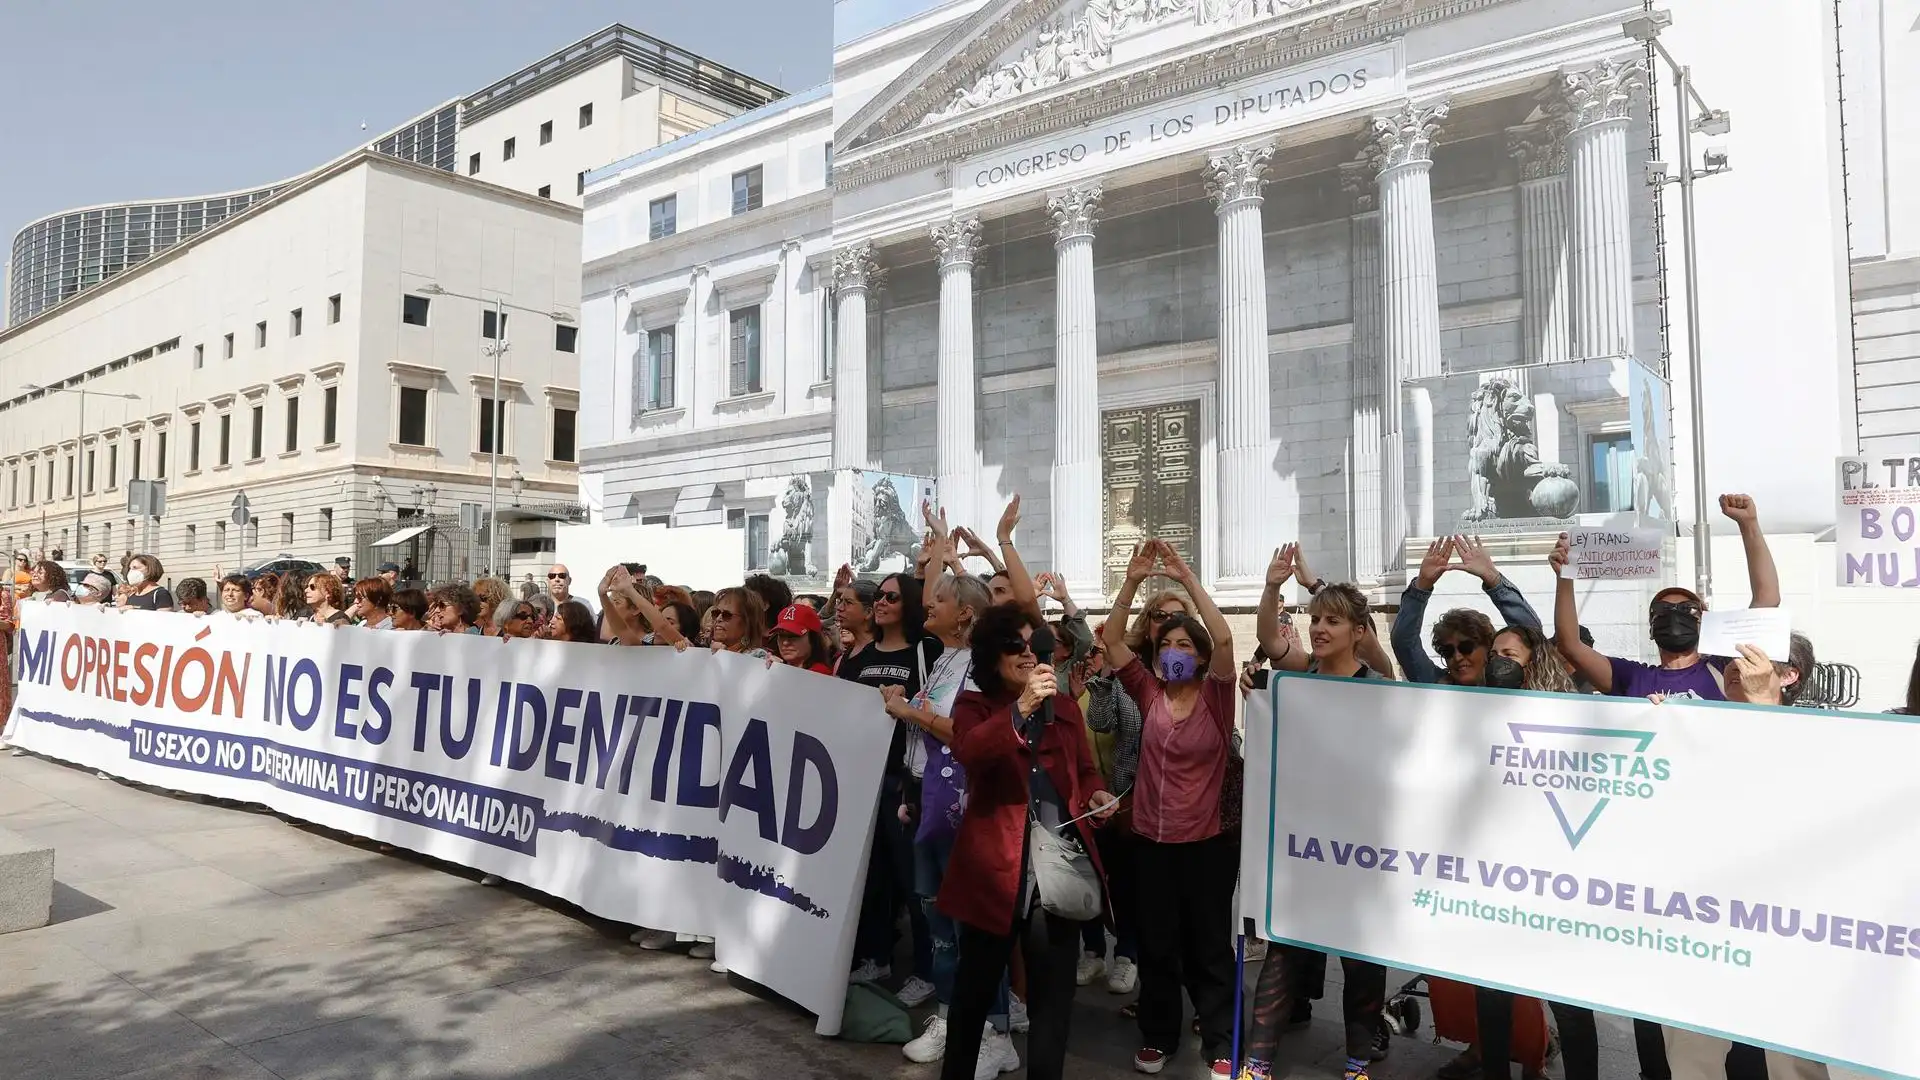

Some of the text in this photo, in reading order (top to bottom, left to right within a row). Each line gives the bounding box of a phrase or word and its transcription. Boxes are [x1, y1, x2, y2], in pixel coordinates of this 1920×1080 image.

[974, 67, 1368, 188] CONGRESO DE LOS DIPUTADOS
[1861, 506, 1915, 542] BO
[18, 625, 838, 855] MI OPRESIÓN NO ES TU IDENTIDAD
[1489, 745, 1671, 782] FEMINISTAS
[133, 728, 536, 844] TU SEXO NO DETERMINA TU PERSONALIDAD
[1502, 769, 1655, 800] AL CONGRESO
[1288, 834, 1325, 863] LA
[1330, 840, 1400, 873] VOZ
[1405, 850, 1430, 876] Y
[1436, 855, 1470, 884] EL
[1477, 860, 1579, 901] VOTO
[1586, 878, 1635, 912] DE
[1643, 886, 1722, 924] LAS
[1411, 888, 1752, 969] #juntasharemoshistoria
